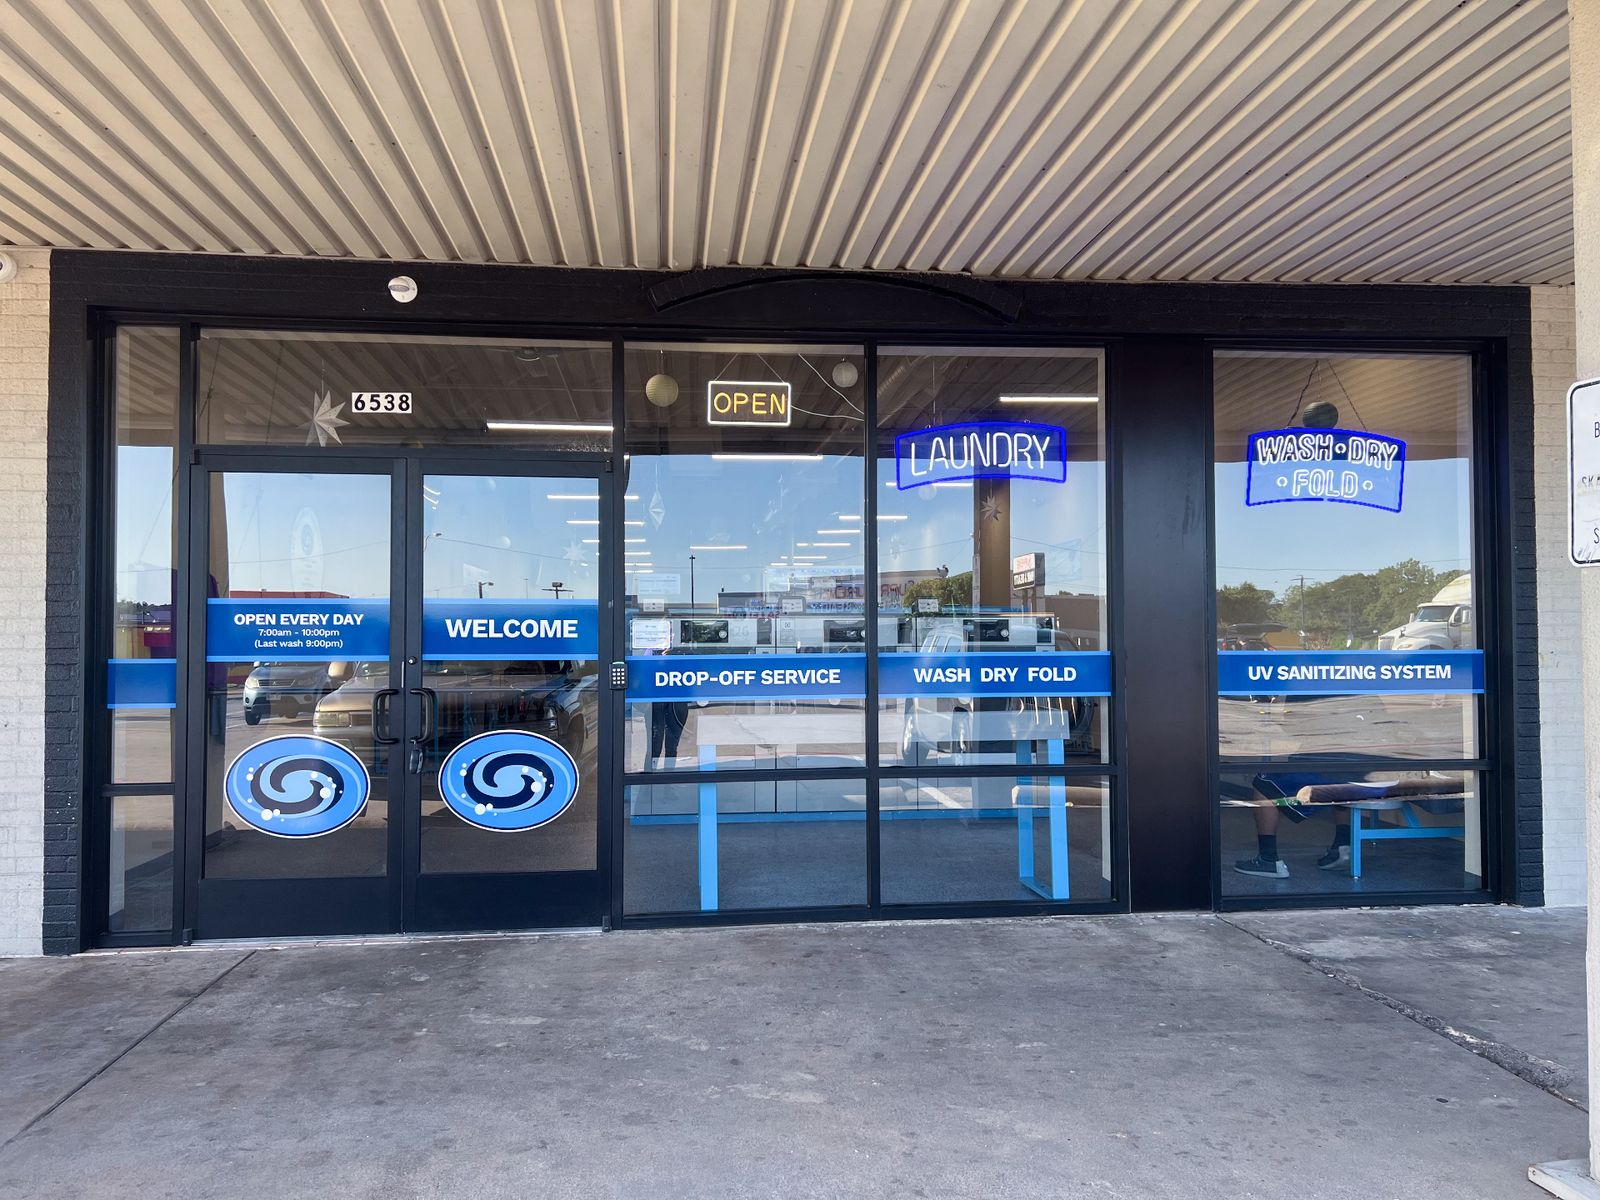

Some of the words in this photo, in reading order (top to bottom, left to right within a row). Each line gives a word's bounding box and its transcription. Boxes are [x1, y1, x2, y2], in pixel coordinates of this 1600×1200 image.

[354, 394, 410, 411] 6538
[713, 392, 786, 415] OPEN
[911, 432, 1050, 476] LAUNDRY
[1256, 434, 1334, 466] WASH
[1348, 437, 1398, 471] DRY
[1292, 468, 1358, 498] FOLD
[233, 613, 276, 626] OPEN
[280, 613, 330, 626] EVERY
[333, 613, 364, 626] DAY
[258, 628, 292, 637] 7:00am
[301, 628, 340, 639] 10:00pm
[445, 618, 578, 640] WELCOME
[254, 639, 277, 649] (Last
[280, 639, 304, 648] wash
[305, 639, 344, 649] 9:00pm)
[655, 670, 757, 687] DROP-OFF
[761, 668, 841, 685] SERVICE
[913, 667, 971, 683] WASH
[980, 667, 1019, 683] DRY
[1028, 666, 1077, 682] FOLD
[1248, 666, 1274, 681] UV
[1277, 665, 1377, 681] SANITIZING
[1381, 664, 1452, 680] SYSTEM
